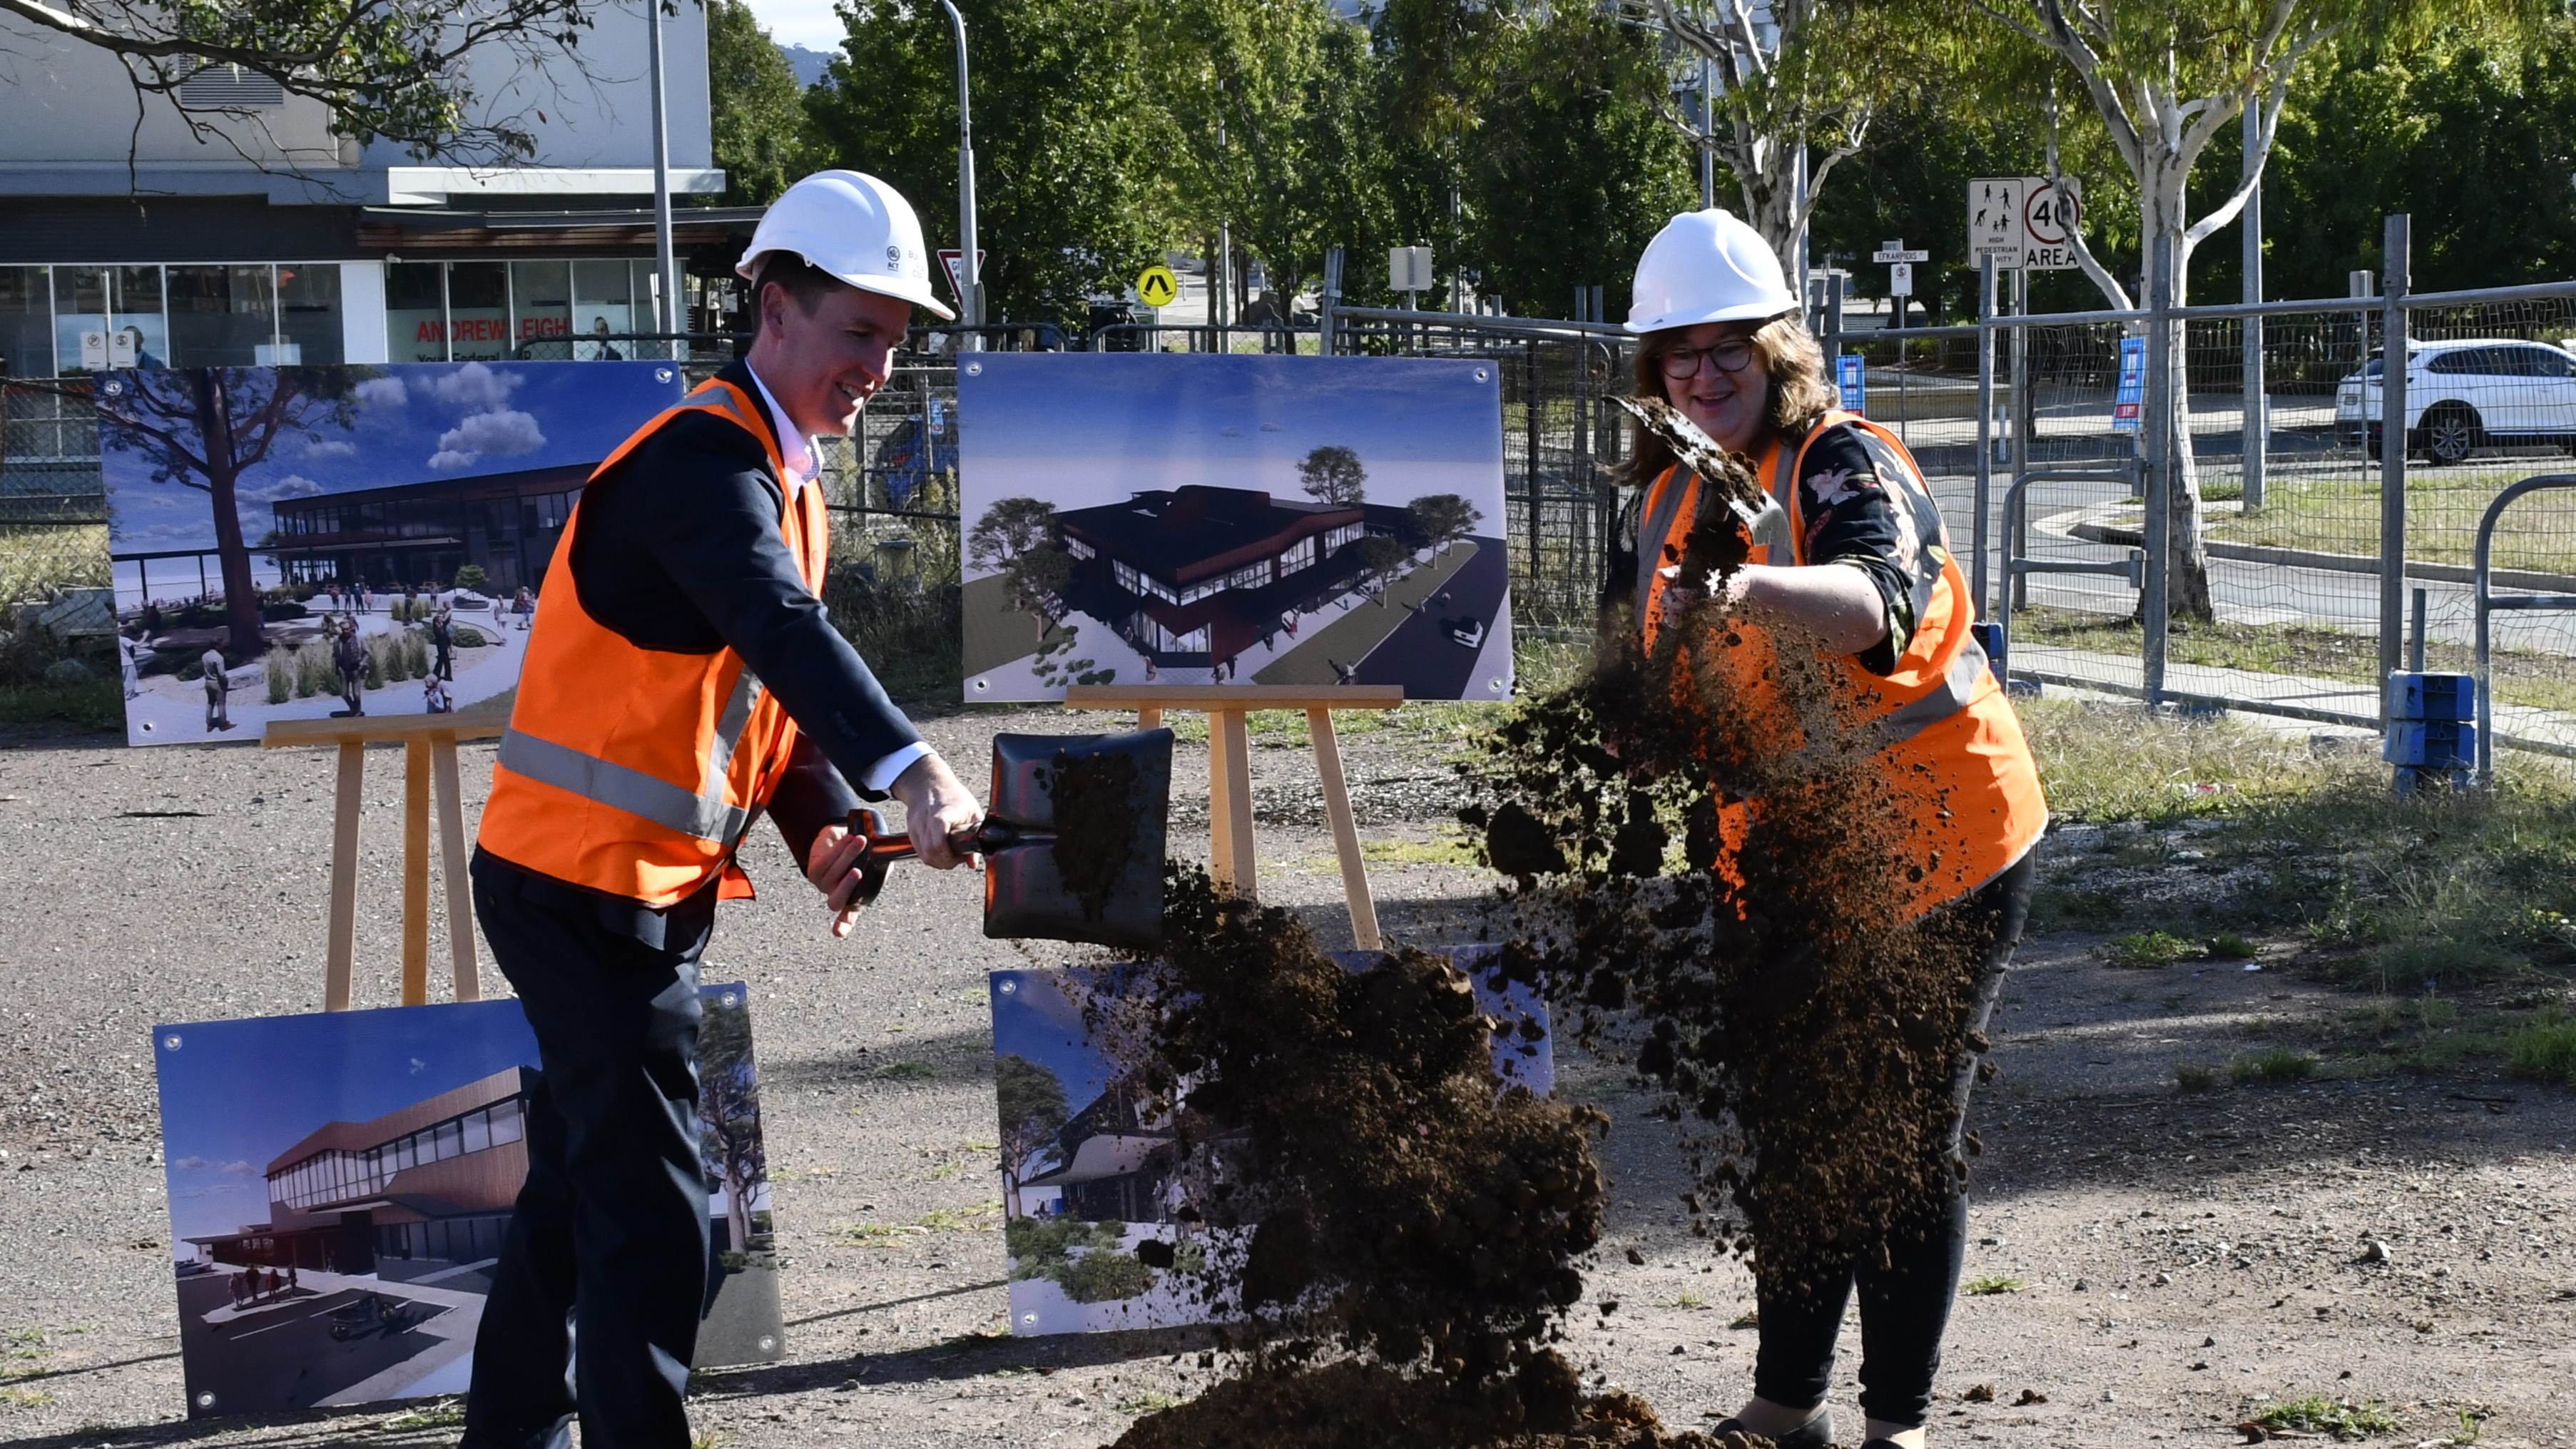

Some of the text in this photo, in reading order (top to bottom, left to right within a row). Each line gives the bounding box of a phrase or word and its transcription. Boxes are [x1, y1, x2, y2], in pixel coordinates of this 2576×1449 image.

[887, 261, 899, 270] ACT
[2025, 248, 2078, 267] AREA
[417, 319, 506, 342] ANDREW
